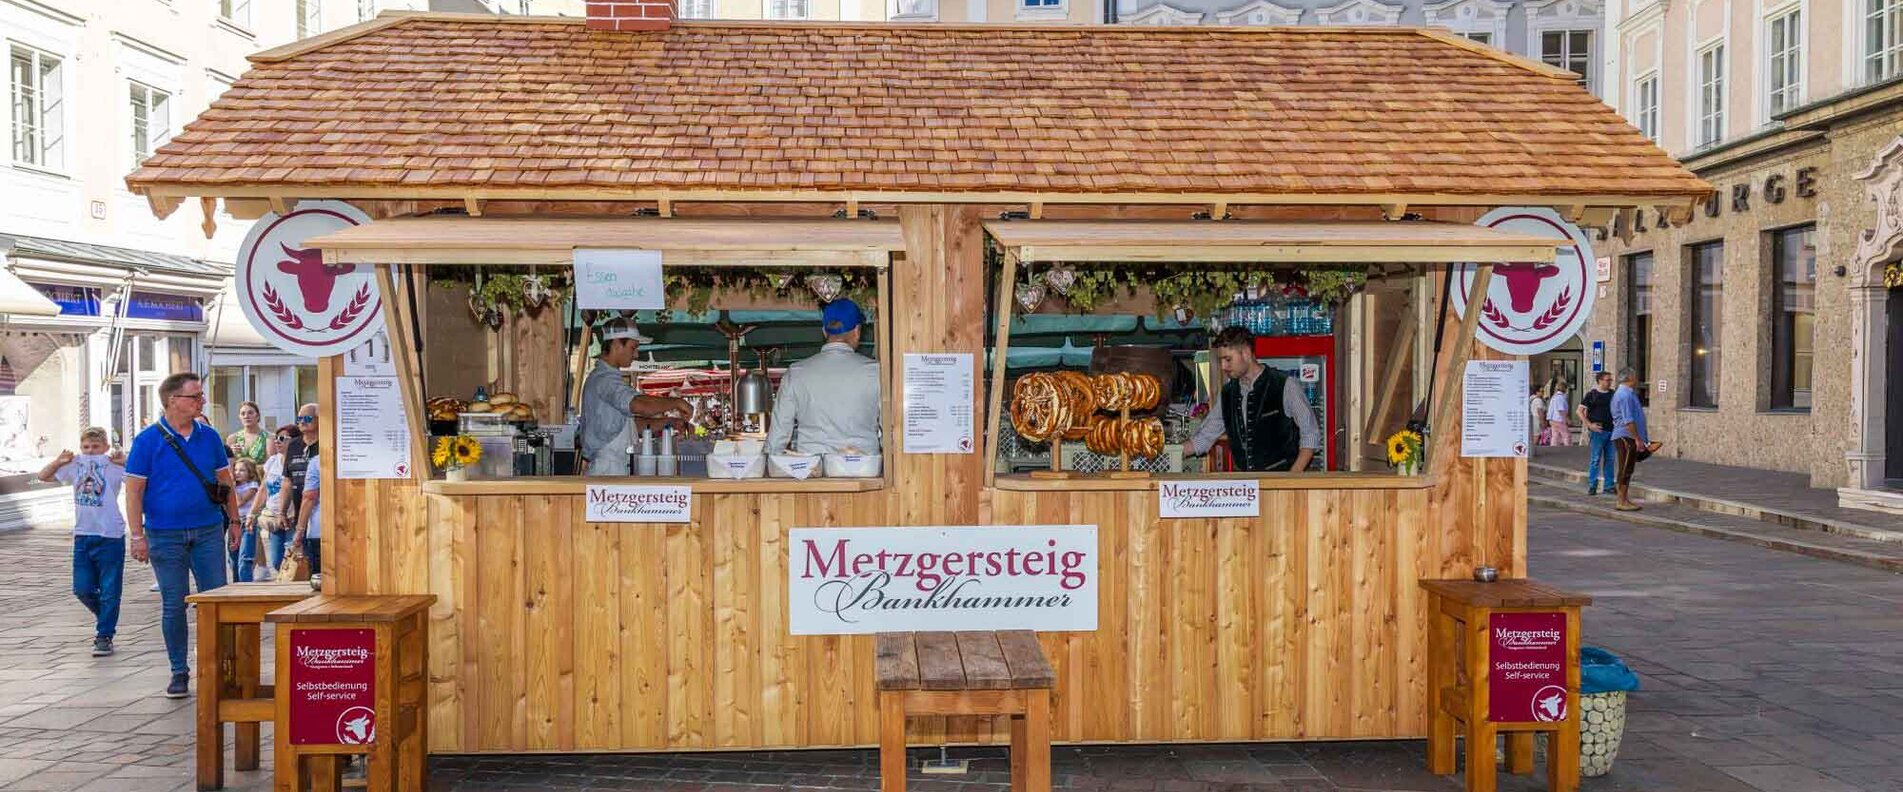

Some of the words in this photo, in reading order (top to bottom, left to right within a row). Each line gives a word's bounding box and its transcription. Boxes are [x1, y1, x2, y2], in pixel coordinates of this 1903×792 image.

[585, 262, 618, 282] Essen
[590, 488, 688, 509] Metzgersteig
[1163, 484, 1256, 501] Metzgersteig
[593, 500, 683, 517] Bankhammer
[1167, 495, 1251, 513] Bankhammer
[801, 538, 1087, 592] Metzgersteig
[814, 569, 1073, 623] Bankhammer
[1495, 627, 1561, 641] Metzgersteig
[296, 645, 368, 660] Metzgersteig
[1495, 661, 1561, 672] Selbstbedienung
[1505, 671, 1550, 680] Self-service
[296, 681, 368, 692] Selbstbedienung
[307, 691, 357, 701] Self-service
